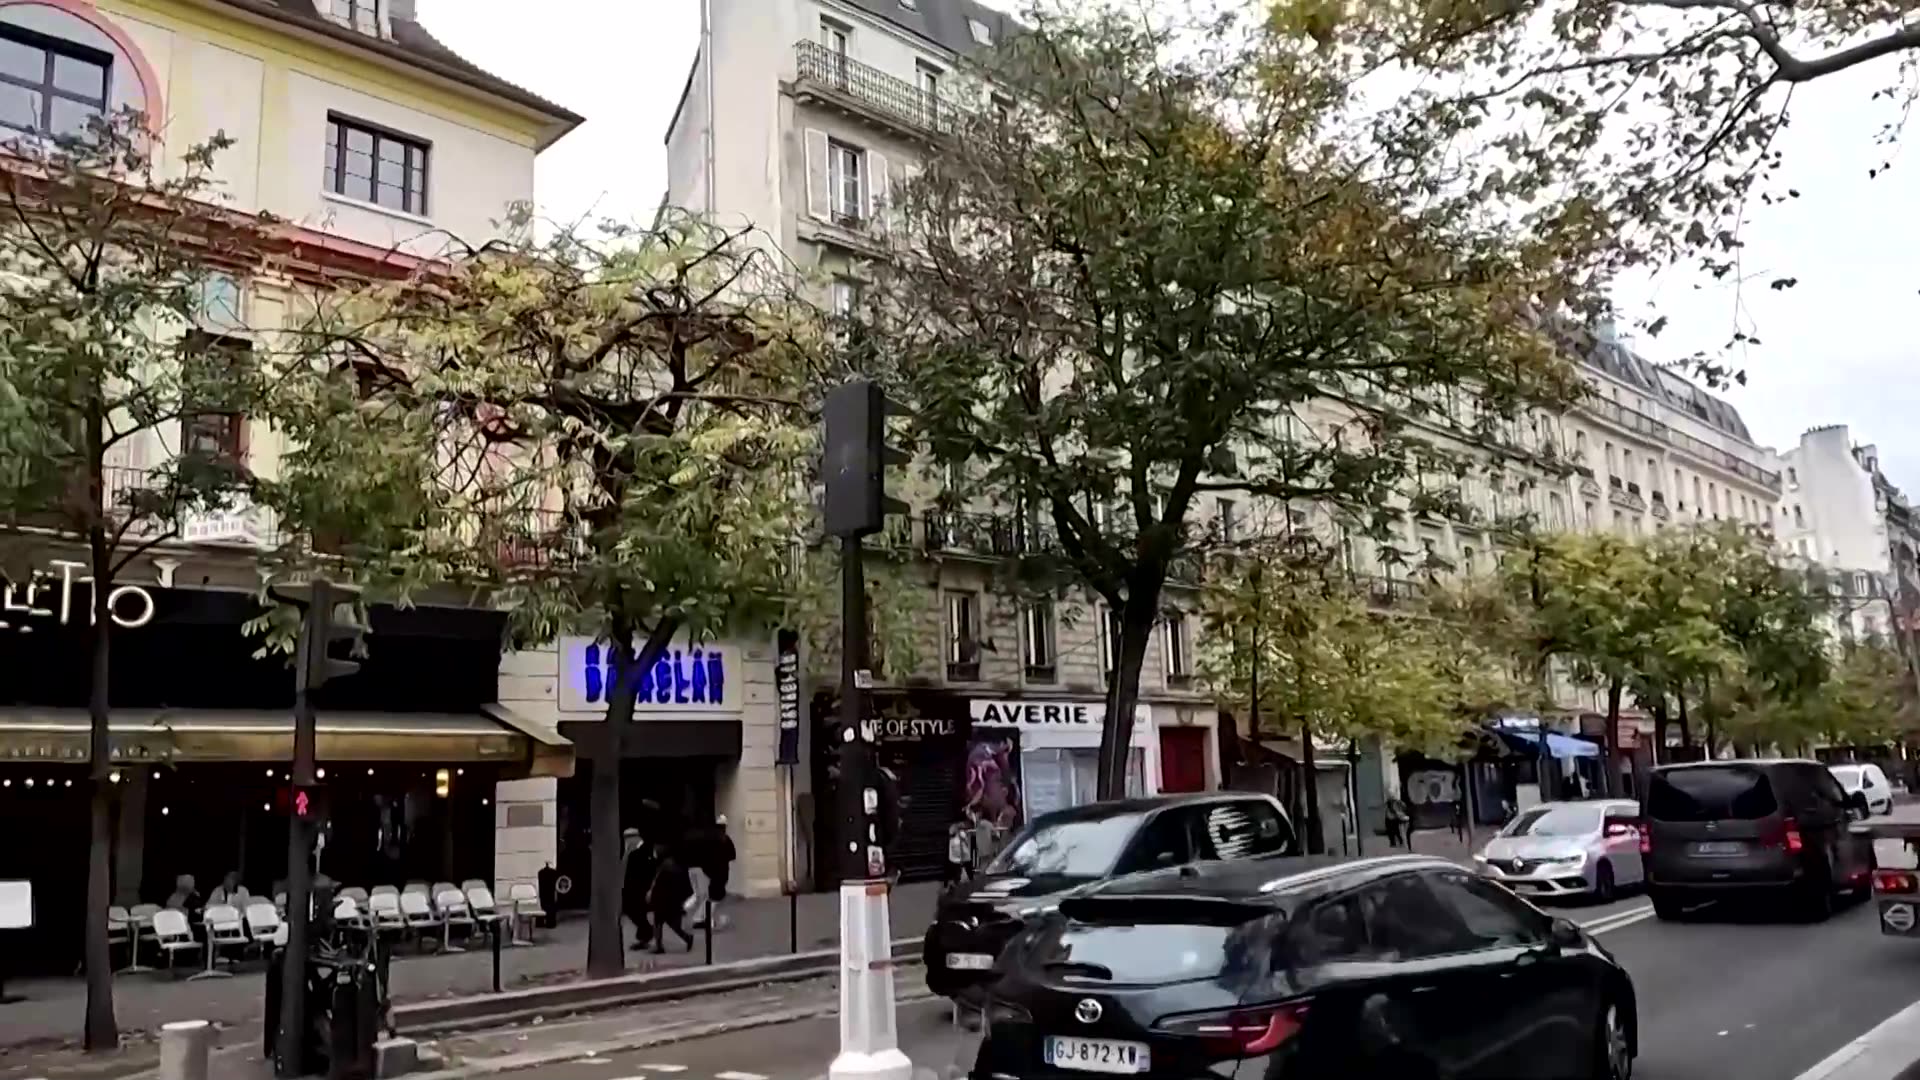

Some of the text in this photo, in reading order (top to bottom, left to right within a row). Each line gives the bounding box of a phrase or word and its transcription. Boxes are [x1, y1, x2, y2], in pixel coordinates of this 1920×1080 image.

[585, 644, 724, 705] BACLAN
[886, 719, 908, 736] OF
[911, 719, 956, 736] STYLE
